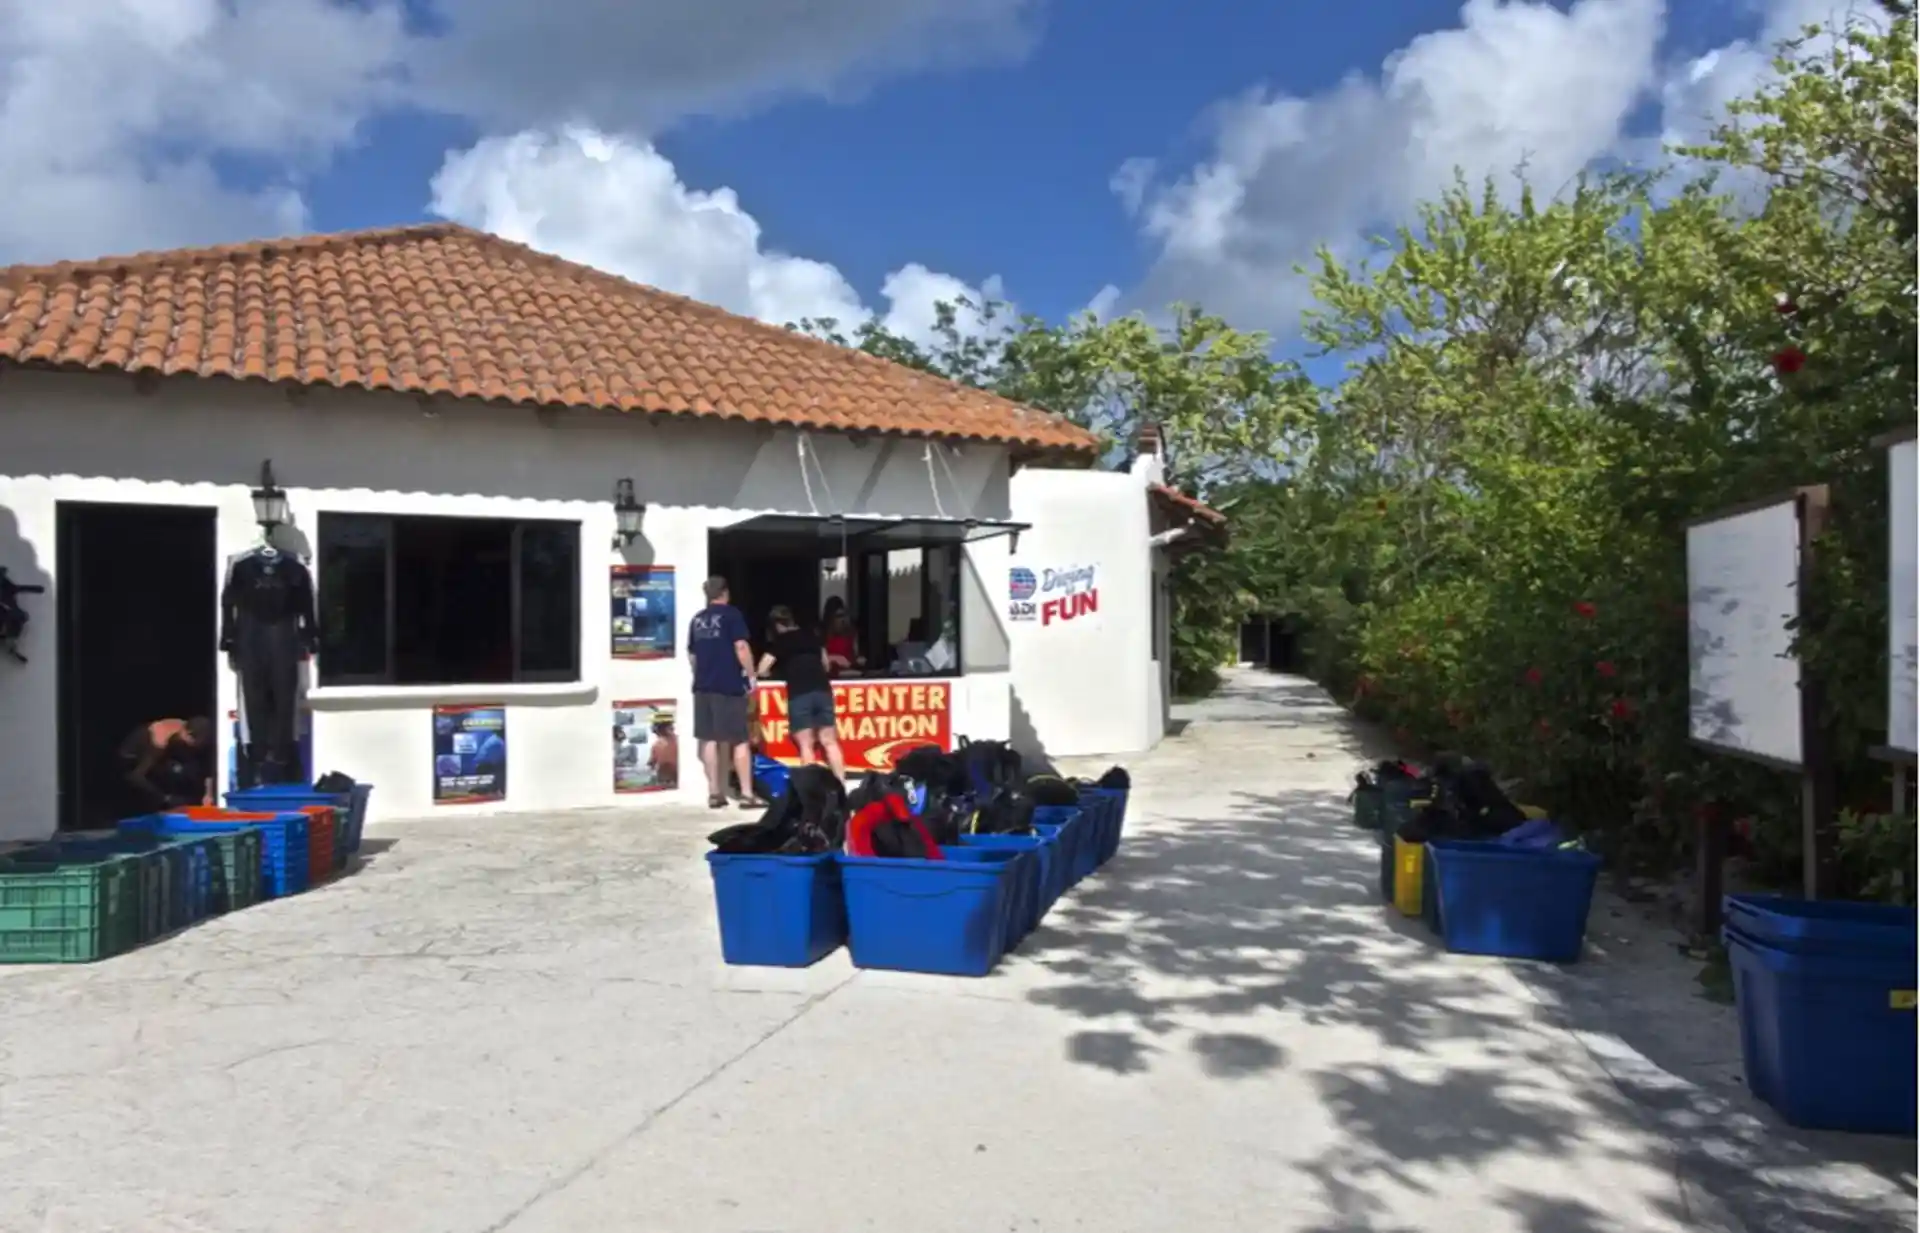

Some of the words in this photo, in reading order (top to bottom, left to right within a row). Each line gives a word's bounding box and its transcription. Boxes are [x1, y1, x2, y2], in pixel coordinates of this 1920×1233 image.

[1041, 588, 1098, 627] FUN
[834, 685, 946, 715] CENTER
[761, 715, 938, 744] NFMATION
